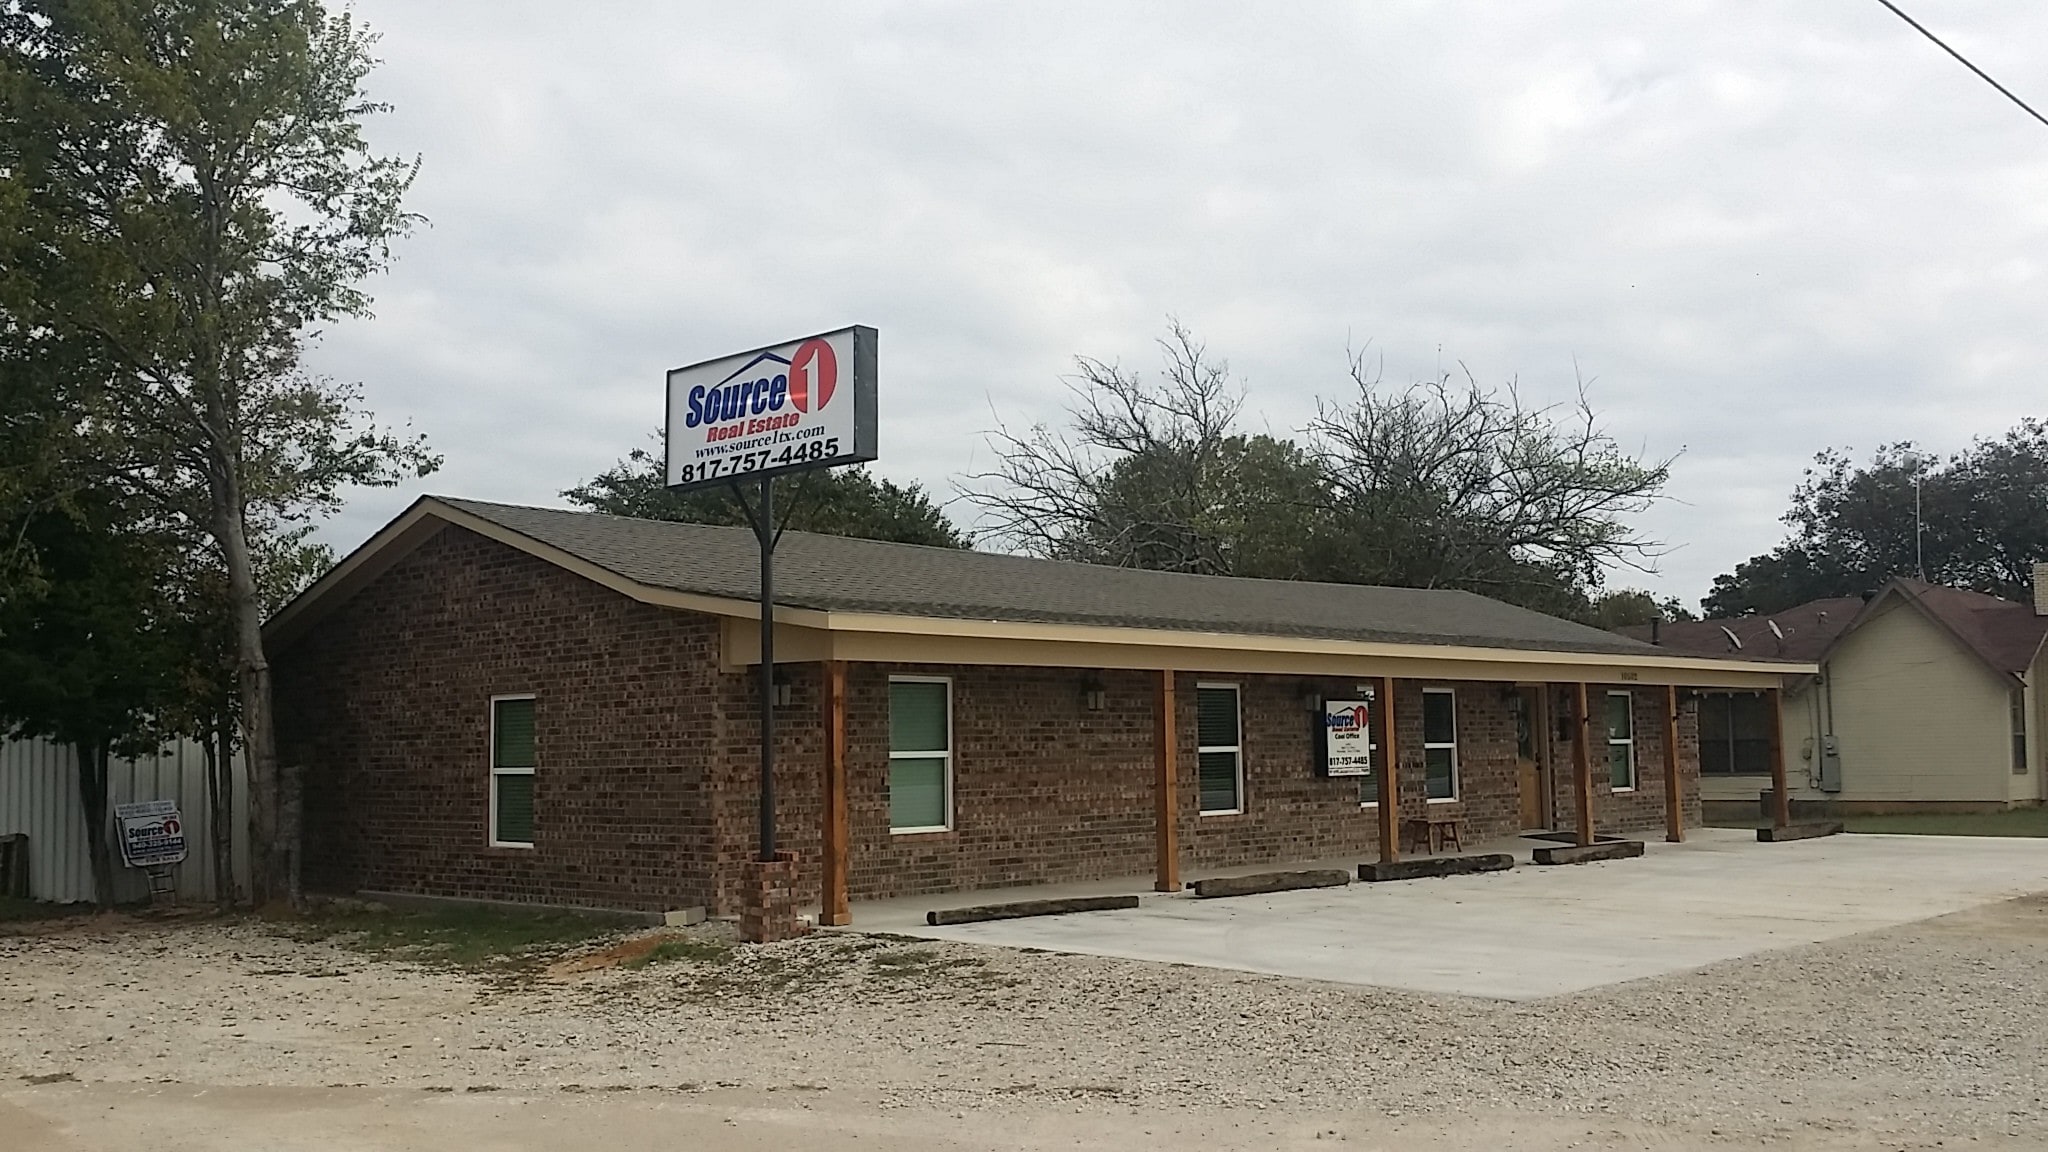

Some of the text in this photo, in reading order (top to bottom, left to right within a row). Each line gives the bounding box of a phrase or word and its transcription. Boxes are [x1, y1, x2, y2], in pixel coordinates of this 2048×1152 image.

[685, 374, 787, 428] Source
[695, 425, 825, 458] www.source1tx.com
[706, 412, 800, 442] Real Estate
[681, 437, 839, 483] 817-757-4485
[1327, 713, 1354, 727] Source
[128, 826, 164, 838] Source
